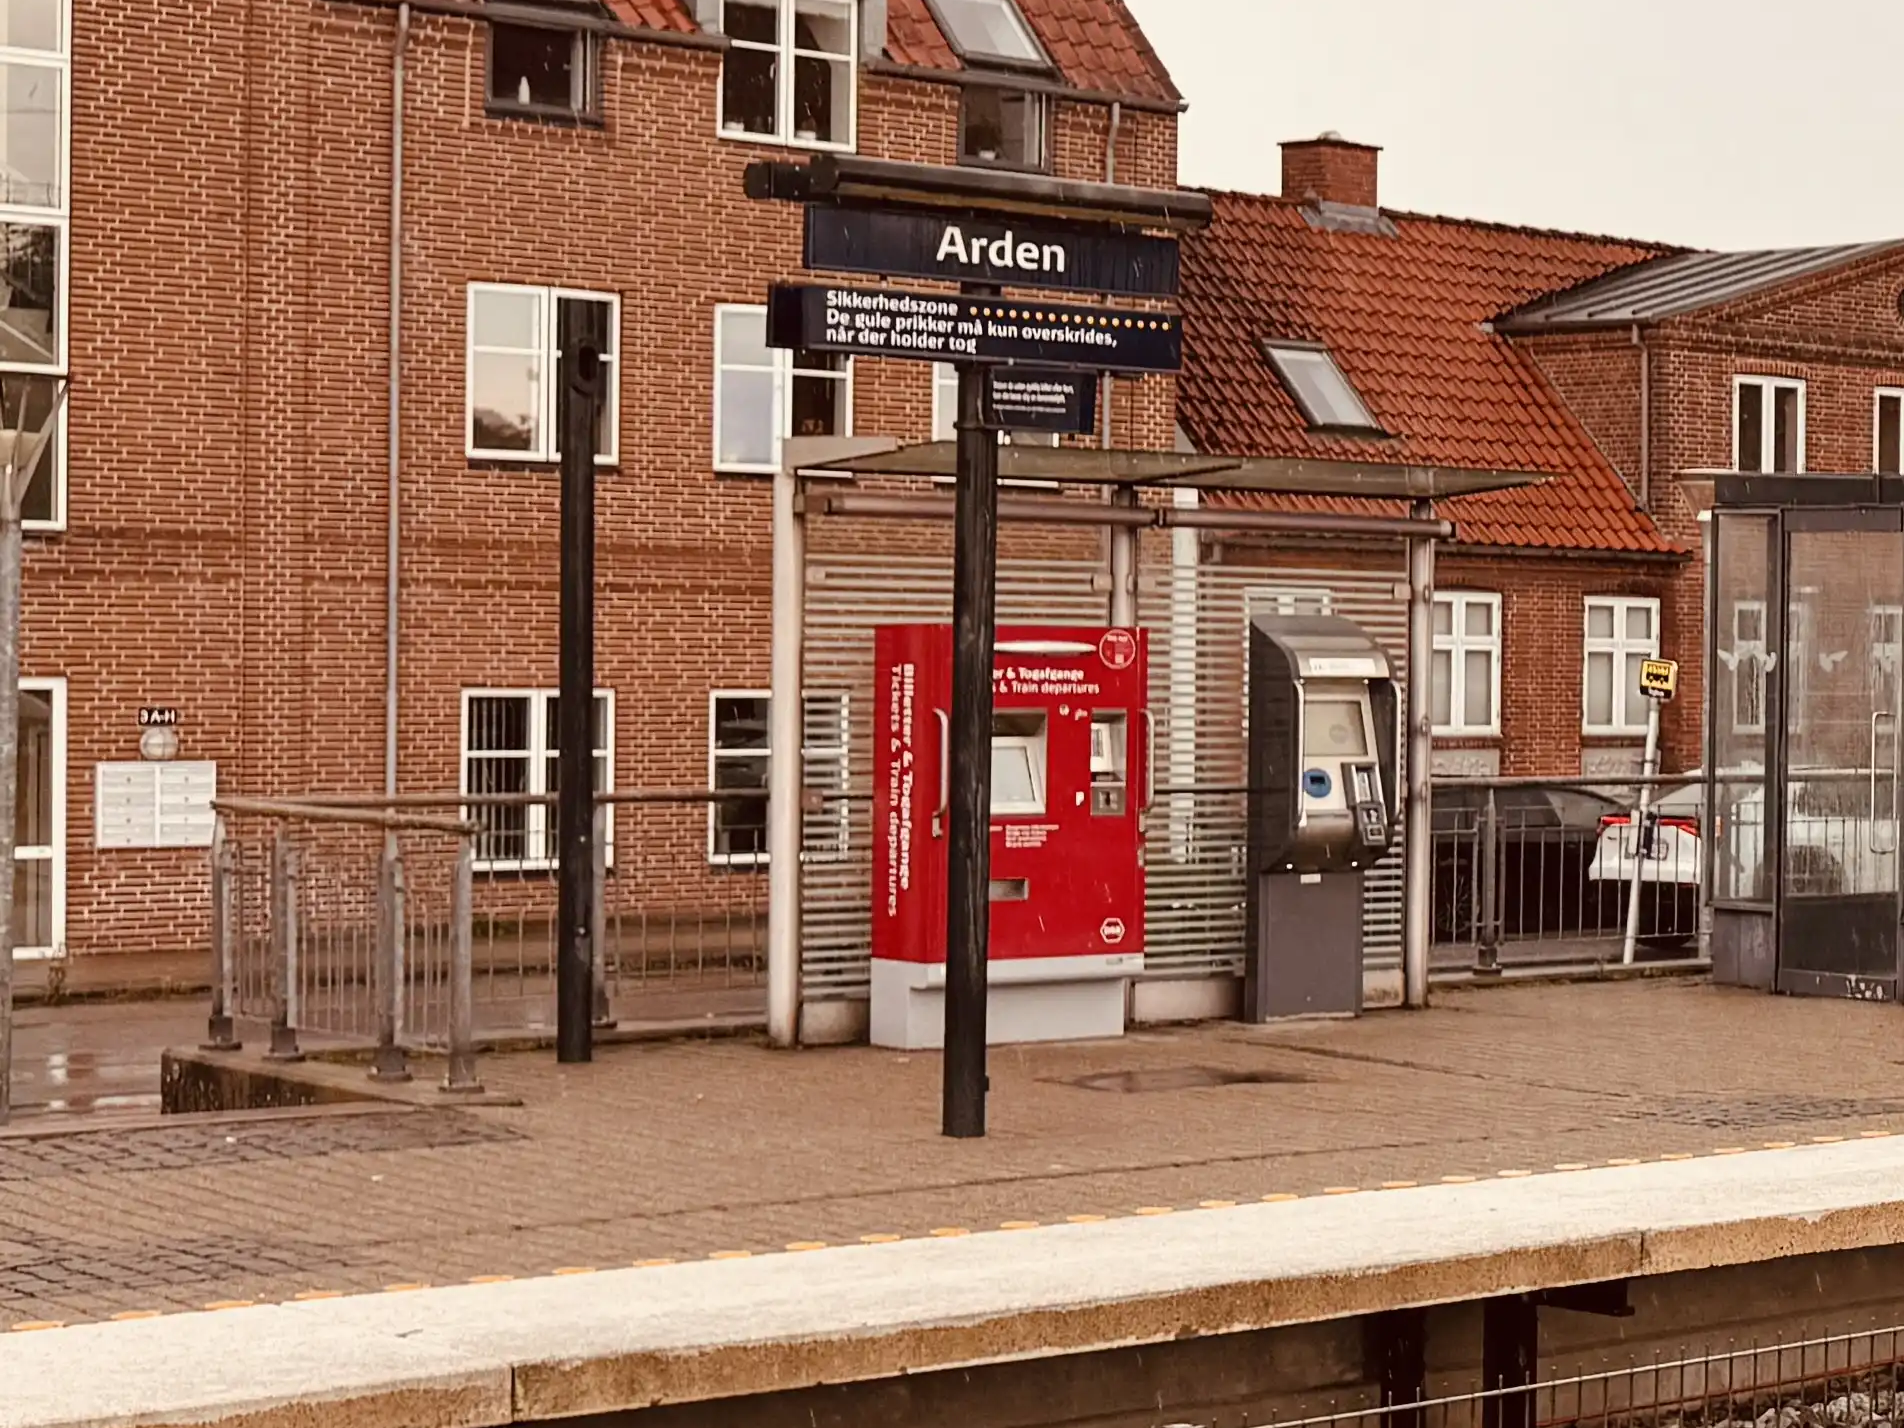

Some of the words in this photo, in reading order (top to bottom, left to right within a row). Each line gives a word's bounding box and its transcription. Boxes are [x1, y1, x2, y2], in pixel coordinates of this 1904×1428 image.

[936, 225, 1065, 272] Arden
[826, 290, 958, 316] Sikkerhedszone
[826, 308, 850, 326] De
[855, 312, 891, 329] gule
[895, 315, 954, 333] prikker
[957, 318, 982, 335] må
[987, 321, 1018, 338] kun
[1022, 325, 1117, 348] overskrides,
[826, 326, 855, 343] når
[858, 328, 887, 346] der
[890, 330, 945, 349] holder
[949, 336, 977, 354] tog
[999, 681, 1008, 693] &
[1012, 681, 1039, 693] Train
[1041, 682, 1100, 696] departures
[1006, 667, 1016, 679] &
[890, 663, 902, 733] Tickets
[903, 663, 914, 747] Billetter
[890, 737, 901, 752] &
[903, 751, 913, 768] &
[889, 758, 901, 806] Train
[888, 811, 900, 917] departures
